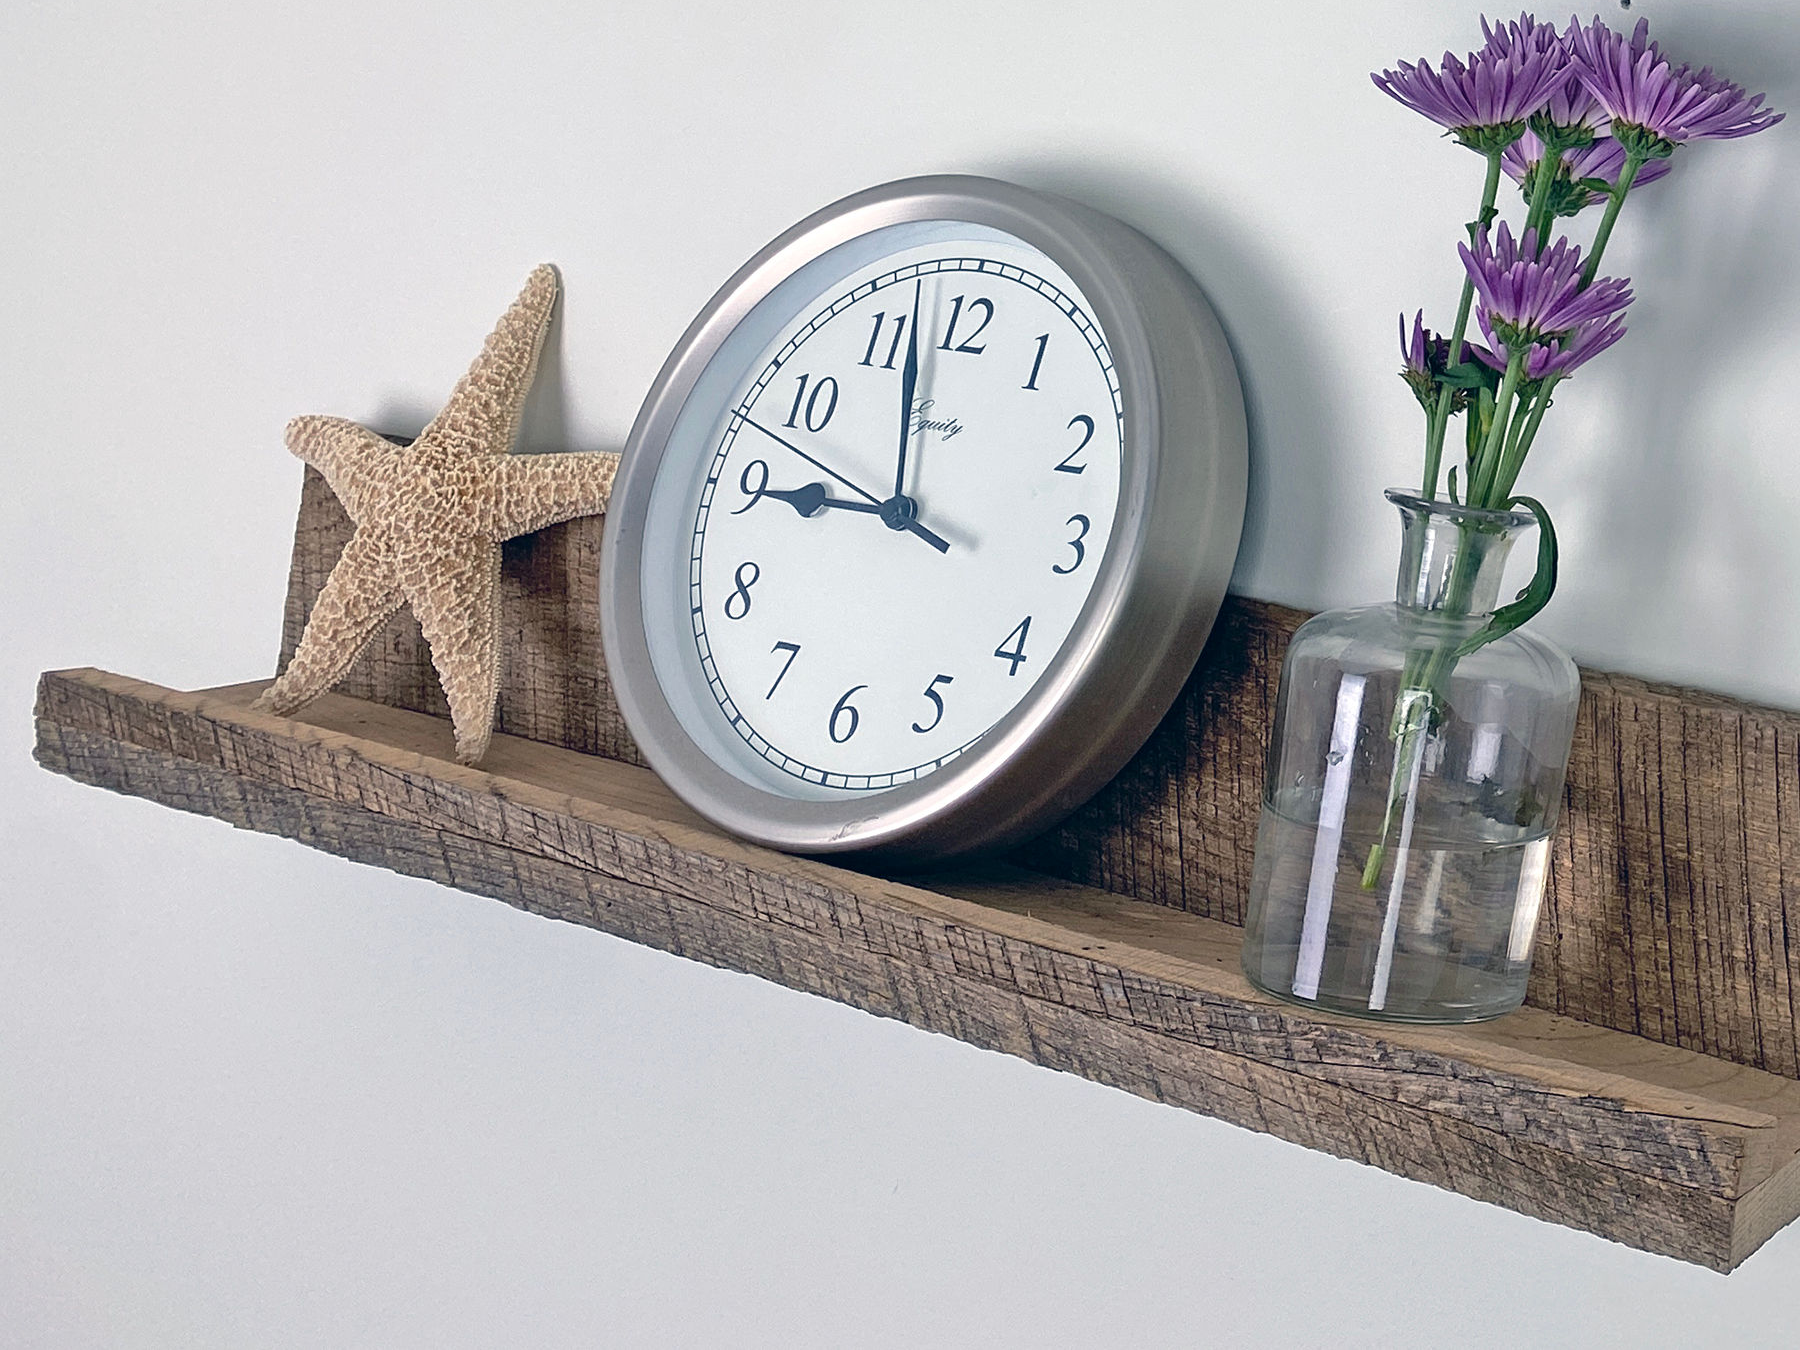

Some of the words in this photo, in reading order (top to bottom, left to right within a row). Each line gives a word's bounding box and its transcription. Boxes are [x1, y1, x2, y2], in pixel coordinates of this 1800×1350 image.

[857, 311, 908, 371] 11
[936, 294, 994, 355] 12
[1021, 333, 1050, 391] 1
[781, 373, 839, 433] 10
[1053, 414, 1095, 475] 2
[730, 460, 770, 515] 9
[1052, 514, 1091, 575] 3
[724, 561, 760, 620] 8
[765, 640, 801, 700] 7
[993, 615, 1032, 677] 4
[828, 685, 869, 744] 6
[911, 674, 954, 734] 5
